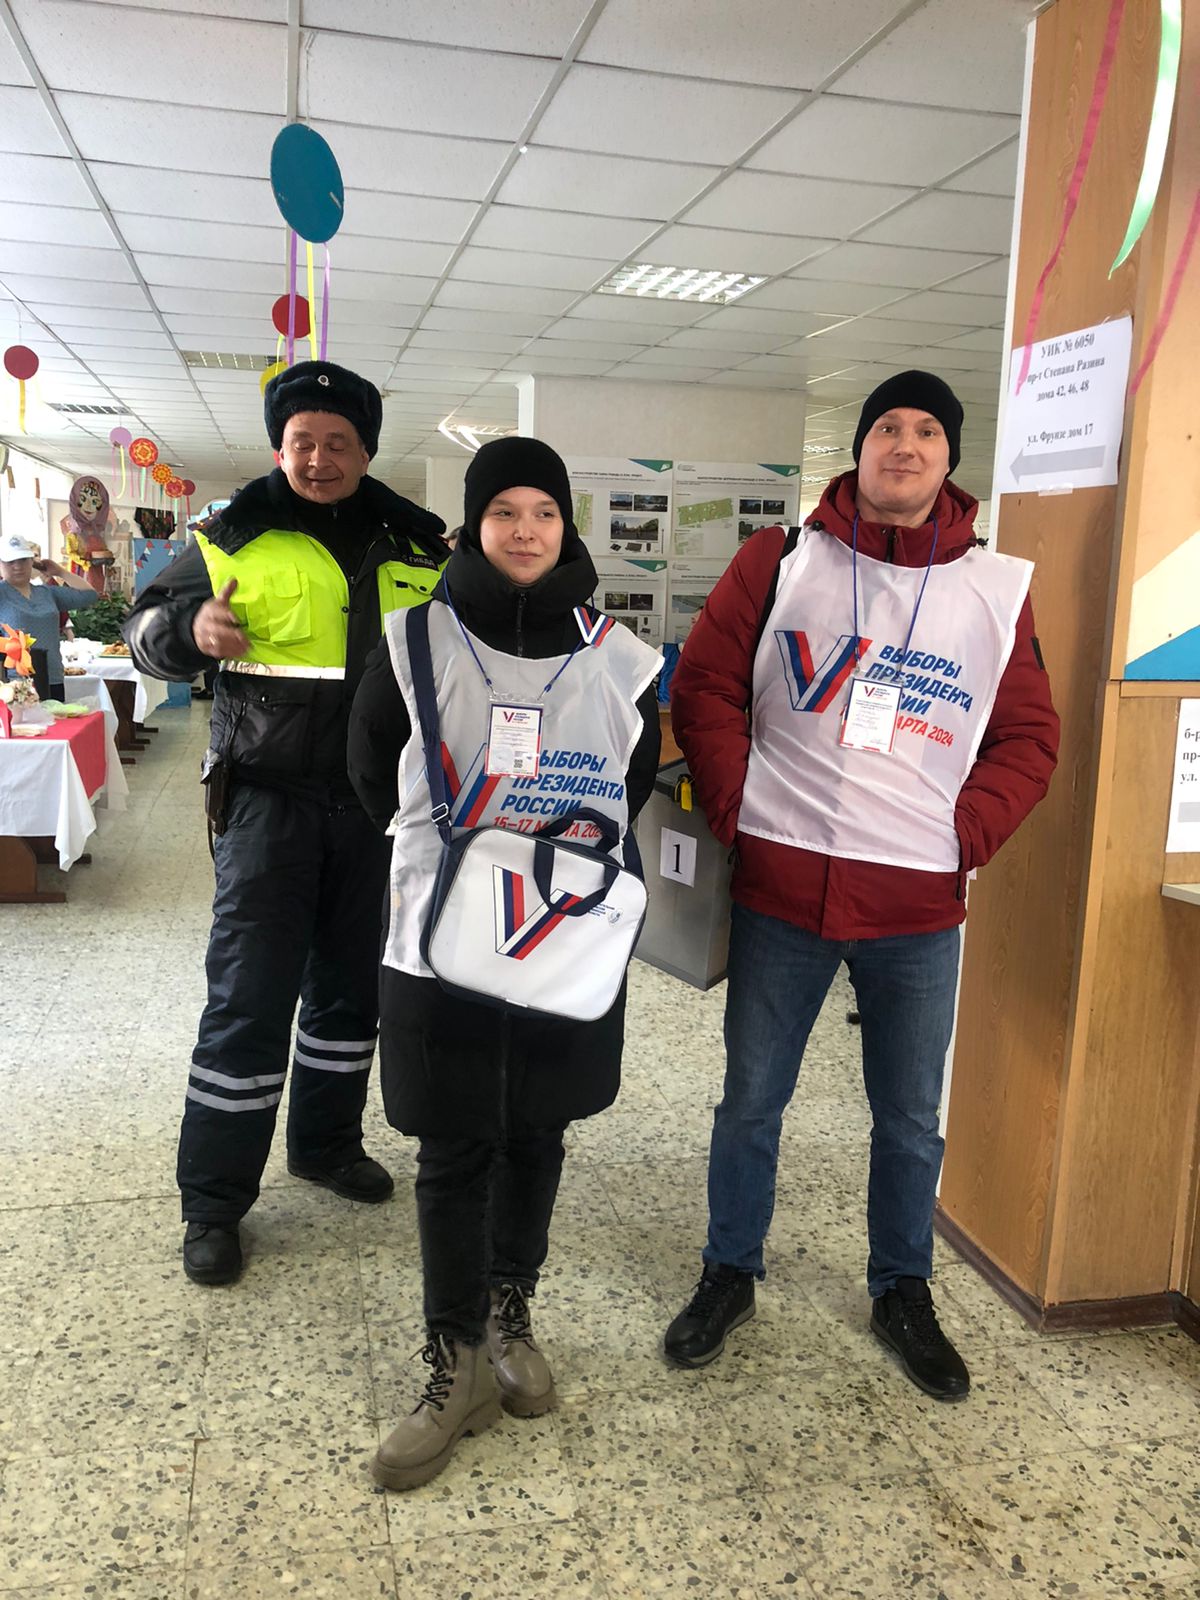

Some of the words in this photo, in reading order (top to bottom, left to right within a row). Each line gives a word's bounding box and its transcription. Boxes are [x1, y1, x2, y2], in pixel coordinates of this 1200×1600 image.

[1041, 342, 1061, 358] УИК
[1062, 338, 1073, 353] №
[1074, 333, 1095, 349] 6050
[1043, 363, 1075, 379] Степана
[1076, 357, 1105, 371] Разина
[1037, 391, 1055, 401] дома
[1079, 379, 1090, 391] 48
[1039, 429, 1066, 444] Фрунзе
[1067, 427, 1082, 439] дом
[1084, 423, 1094, 435] 17
[879, 645, 962, 679] ВЫБОРЫ
[865, 662, 973, 712] ПРЕЗИДЕНТА
[928, 726, 954, 747] 2024
[539, 749, 607, 773] ЫБОРЫ
[512, 773, 624, 801] ПРЕЗИДЕНТА
[1180, 773, 1198, 785] ул.
[501, 794, 582, 816] РОССИИ
[672, 843, 682, 874] 1
